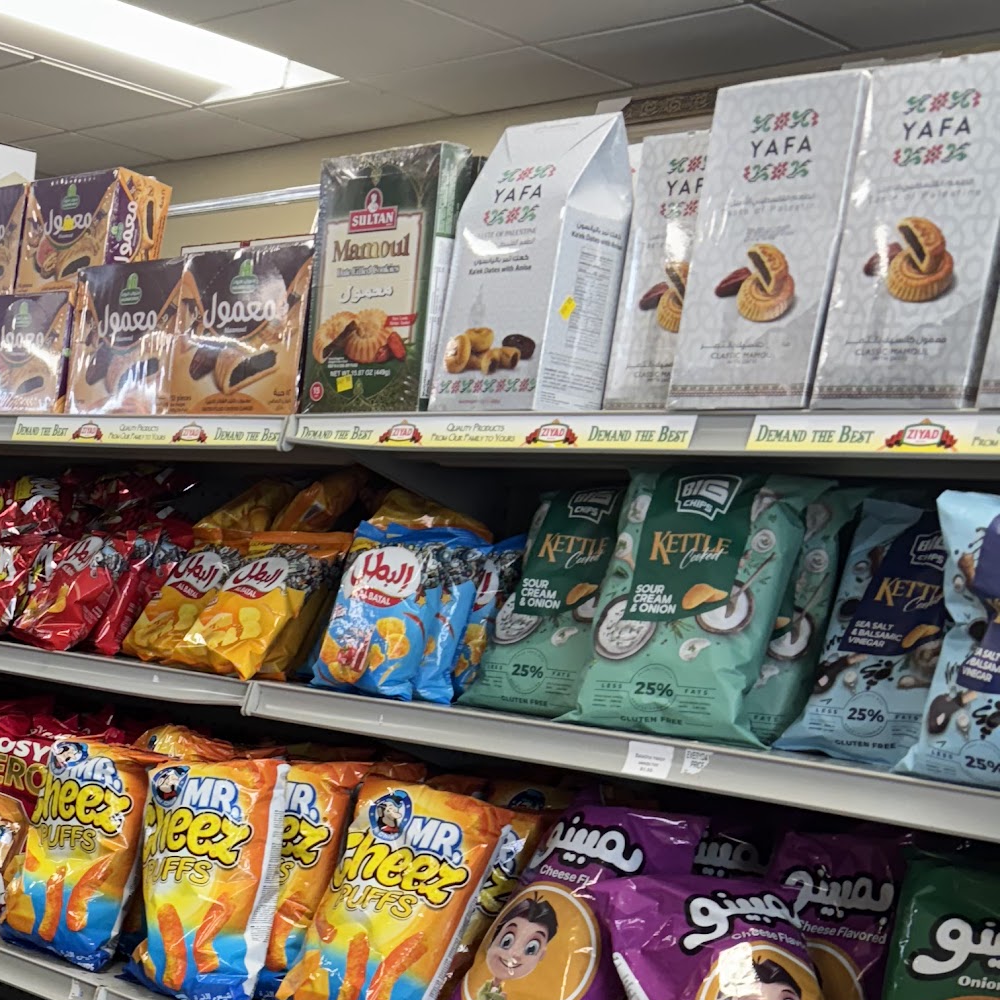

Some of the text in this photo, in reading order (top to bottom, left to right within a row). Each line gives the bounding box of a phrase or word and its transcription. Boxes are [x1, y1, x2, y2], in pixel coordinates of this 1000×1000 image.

[903, 117, 971, 141] YAFA
[751, 136, 812, 158] YAFA
[494, 184, 542, 203] YAFA
[667, 177, 703, 196] YAF
[352, 210, 394, 227] SULTAN
[332, 233, 410, 263] Mamoul
[203, 293, 277, 328] معمول
[98, 304, 158, 338] معمول
[16, 423, 69, 436] DEMAND THE BEST
[214, 427, 281, 442] DEMAND THE BEST
[301, 427, 373, 440] DEMAND THE BEST
[392, 427, 412, 437] ZIYAD
[446, 423, 504, 433] QUALITY PRODUCTS
[541, 427, 565, 437] ZIYAD
[587, 424, 688, 444] DEMAND THE BEST
[756, 425, 874, 444] DEMAND THE BEST
[905, 428, 939, 440] ZIYAD
[449, 434, 463, 442] OUR
[495, 434, 515, 442] YOURS
[682, 480, 730, 502] BIG
[683, 498, 714, 513] CHIPS
[538, 533, 610, 563] KETTLE
[649, 531, 732, 565] KETTLE
[522, 578, 549, 589] SOUR
[636, 584, 665, 595] SOUR
[521, 588, 557, 599] CREAM
[633, 594, 673, 605] CREAM
[519, 597, 561, 610] & ONION
[630, 604, 676, 614] & ONION
[855, 620, 894, 631] SEA SALT
[847, 636, 885, 648] VINEGAR
[851, 628, 903, 642] & BALSAMIC
[511, 663, 544, 679] 25%
[962, 666, 992, 683] VINEGAR
[601, 682, 623, 690] LESS
[634, 681, 674, 697] 25%
[684, 688, 708, 696] FATS
[815, 707, 838, 715] LESS
[846, 707, 884, 723] 25%
[620, 715, 683, 726] GLUTEN FREE
[834, 738, 870, 748] GLUTEN
[76, 757, 123, 791] MR.
[186, 776, 242, 818] MR.
[405, 814, 464, 864] MR.
[540, 864, 576, 884] Cheese
[334, 884, 418, 920] PUFFS
[732, 928, 778, 941] Cheese
[799, 919, 887, 945] Cheese Flavored
[957, 974, 1000, 991] Onio
